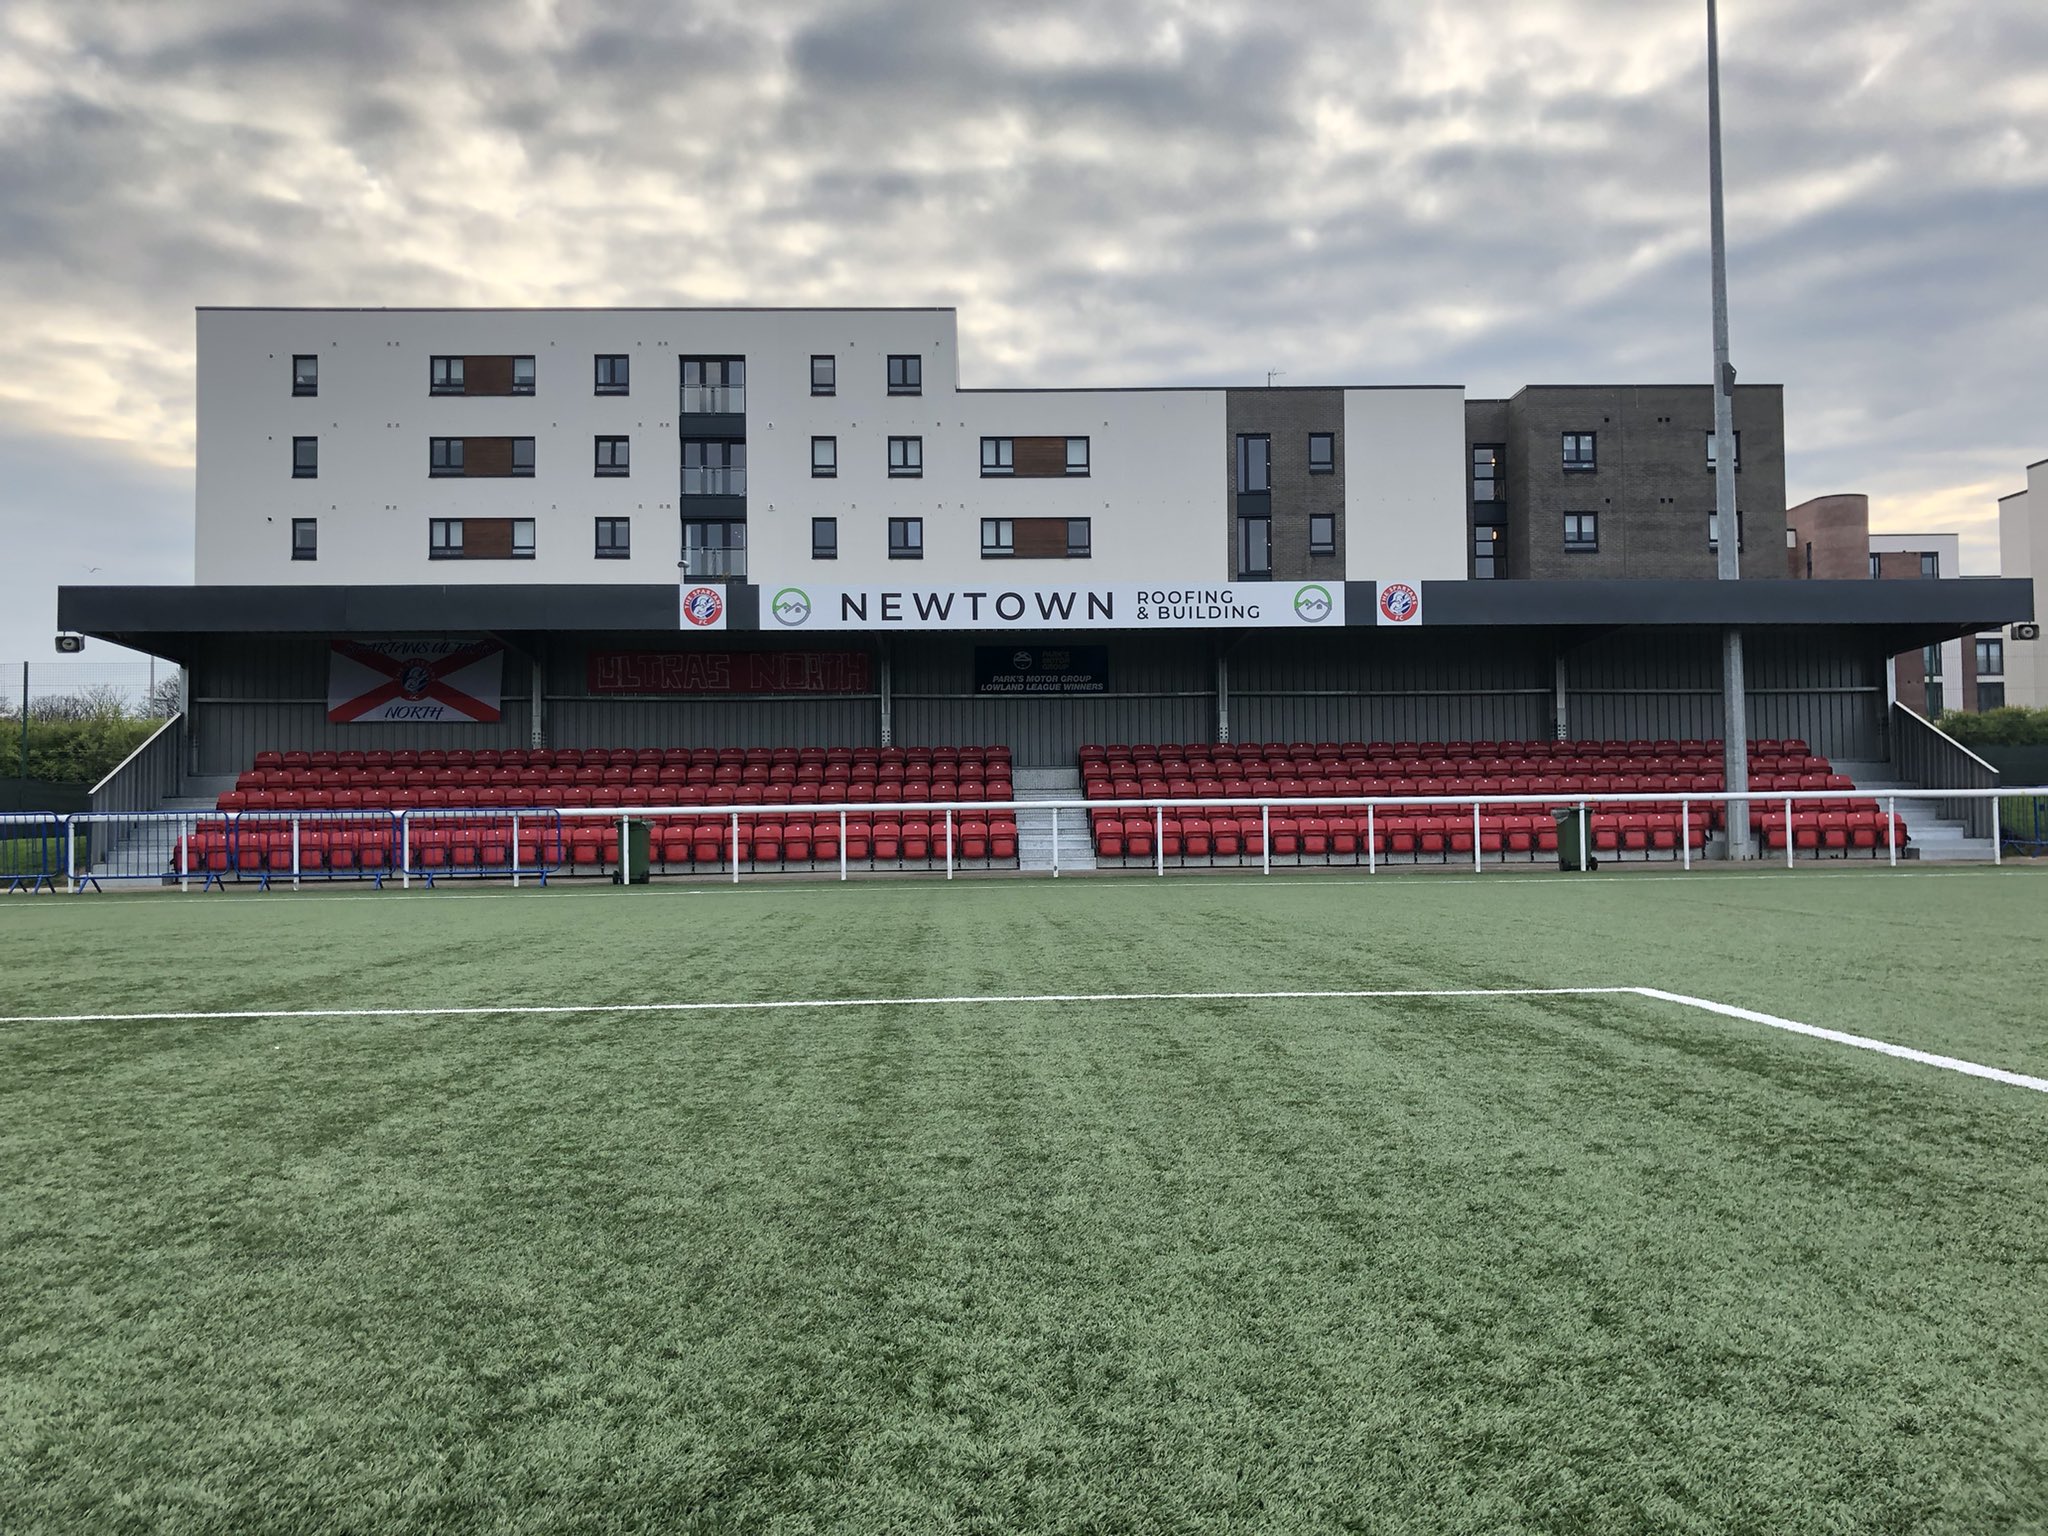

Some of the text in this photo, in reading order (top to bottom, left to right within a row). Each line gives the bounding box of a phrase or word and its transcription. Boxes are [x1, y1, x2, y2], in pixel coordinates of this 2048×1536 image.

[1137, 590, 1233, 605] ROOFING
[842, 592, 1114, 621] NEWTOWN
[1137, 605, 1260, 620] & BUILDING
[598, 653, 868, 690] ULTRAS NORTH
[992, 675, 1092, 683] PARK'S MOTOR GROUP
[981, 683, 1104, 691] LOWLAND LEAGUE WINNERS
[384, 706, 444, 720] NORTH
